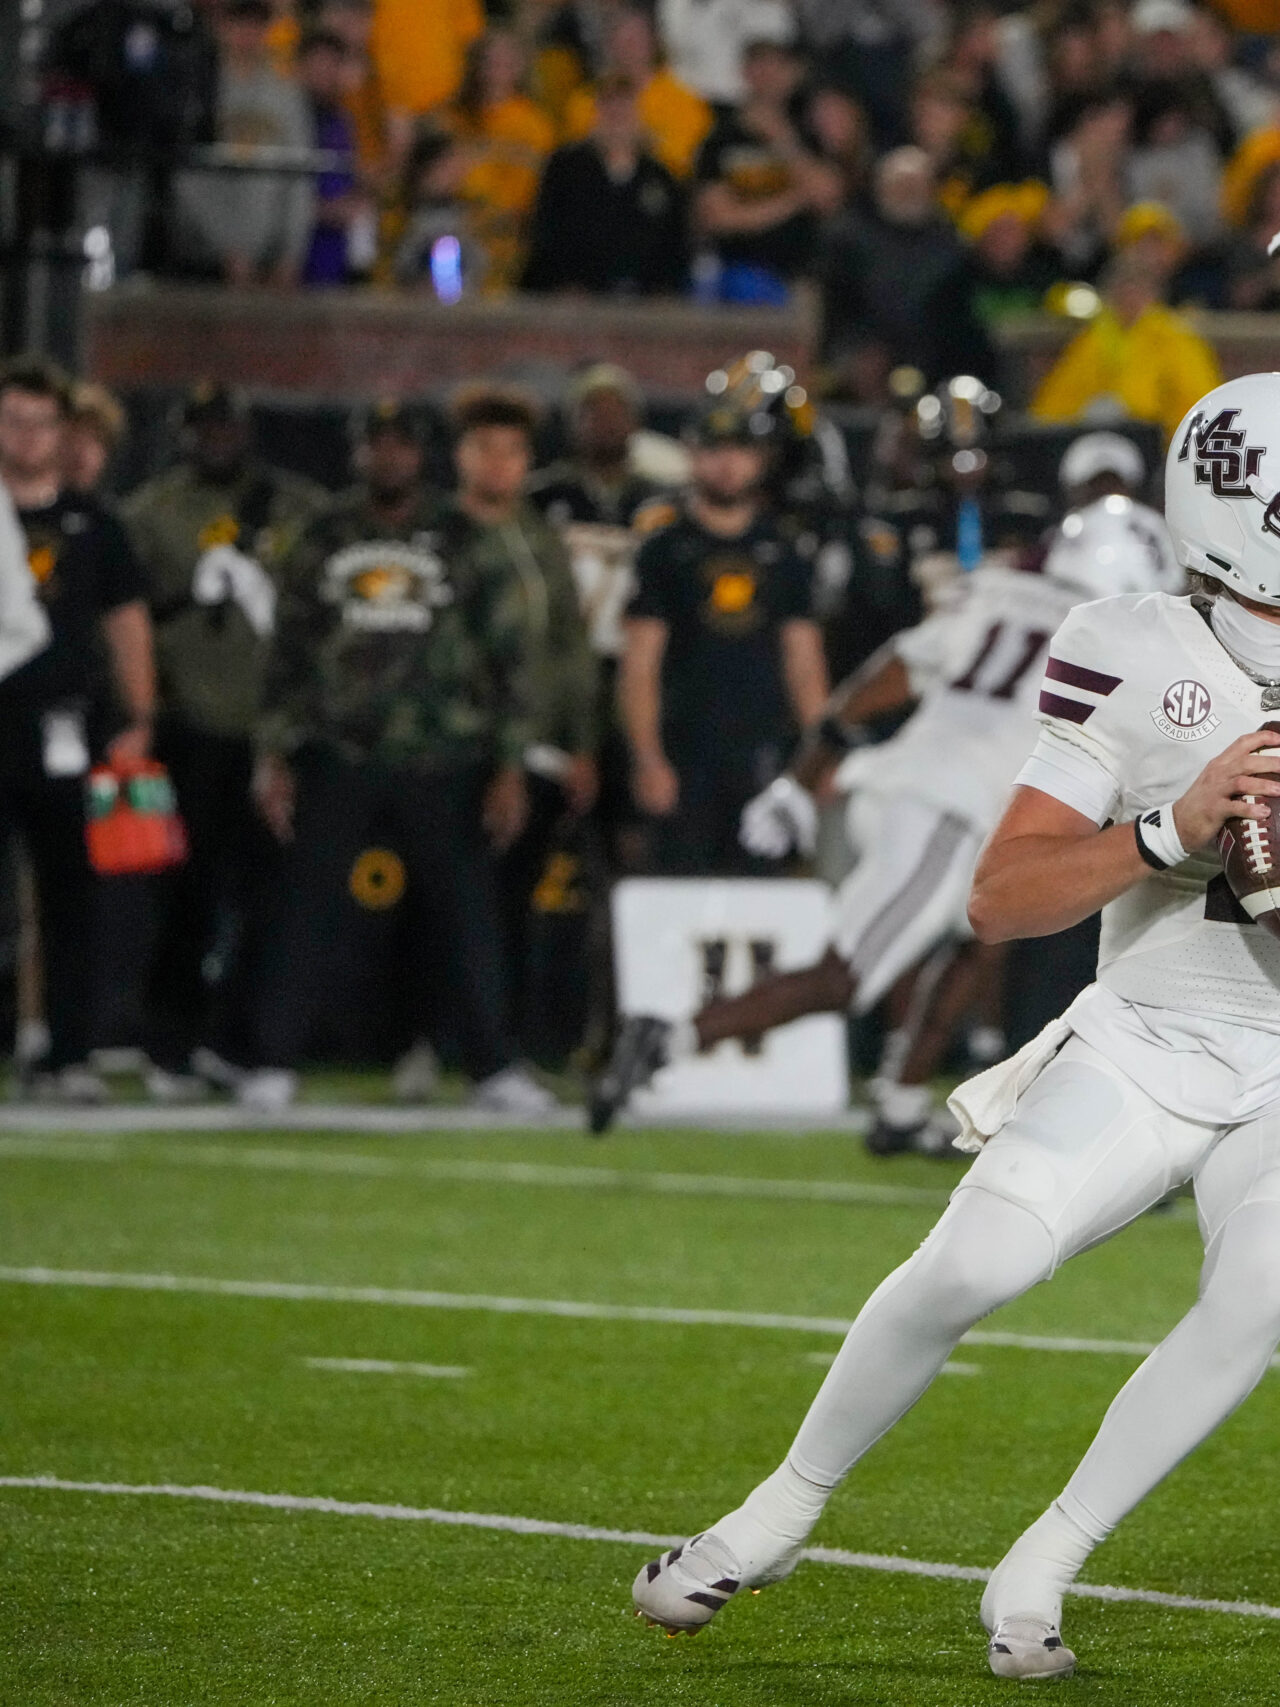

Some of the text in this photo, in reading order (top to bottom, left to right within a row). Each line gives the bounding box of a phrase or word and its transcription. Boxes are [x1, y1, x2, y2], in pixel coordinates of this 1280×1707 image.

[1177, 408, 1267, 499] MSU
[948, 618, 1050, 702] 11
[1158, 718, 1210, 740] GRADUATE
[1165, 681, 1210, 726] SEC
